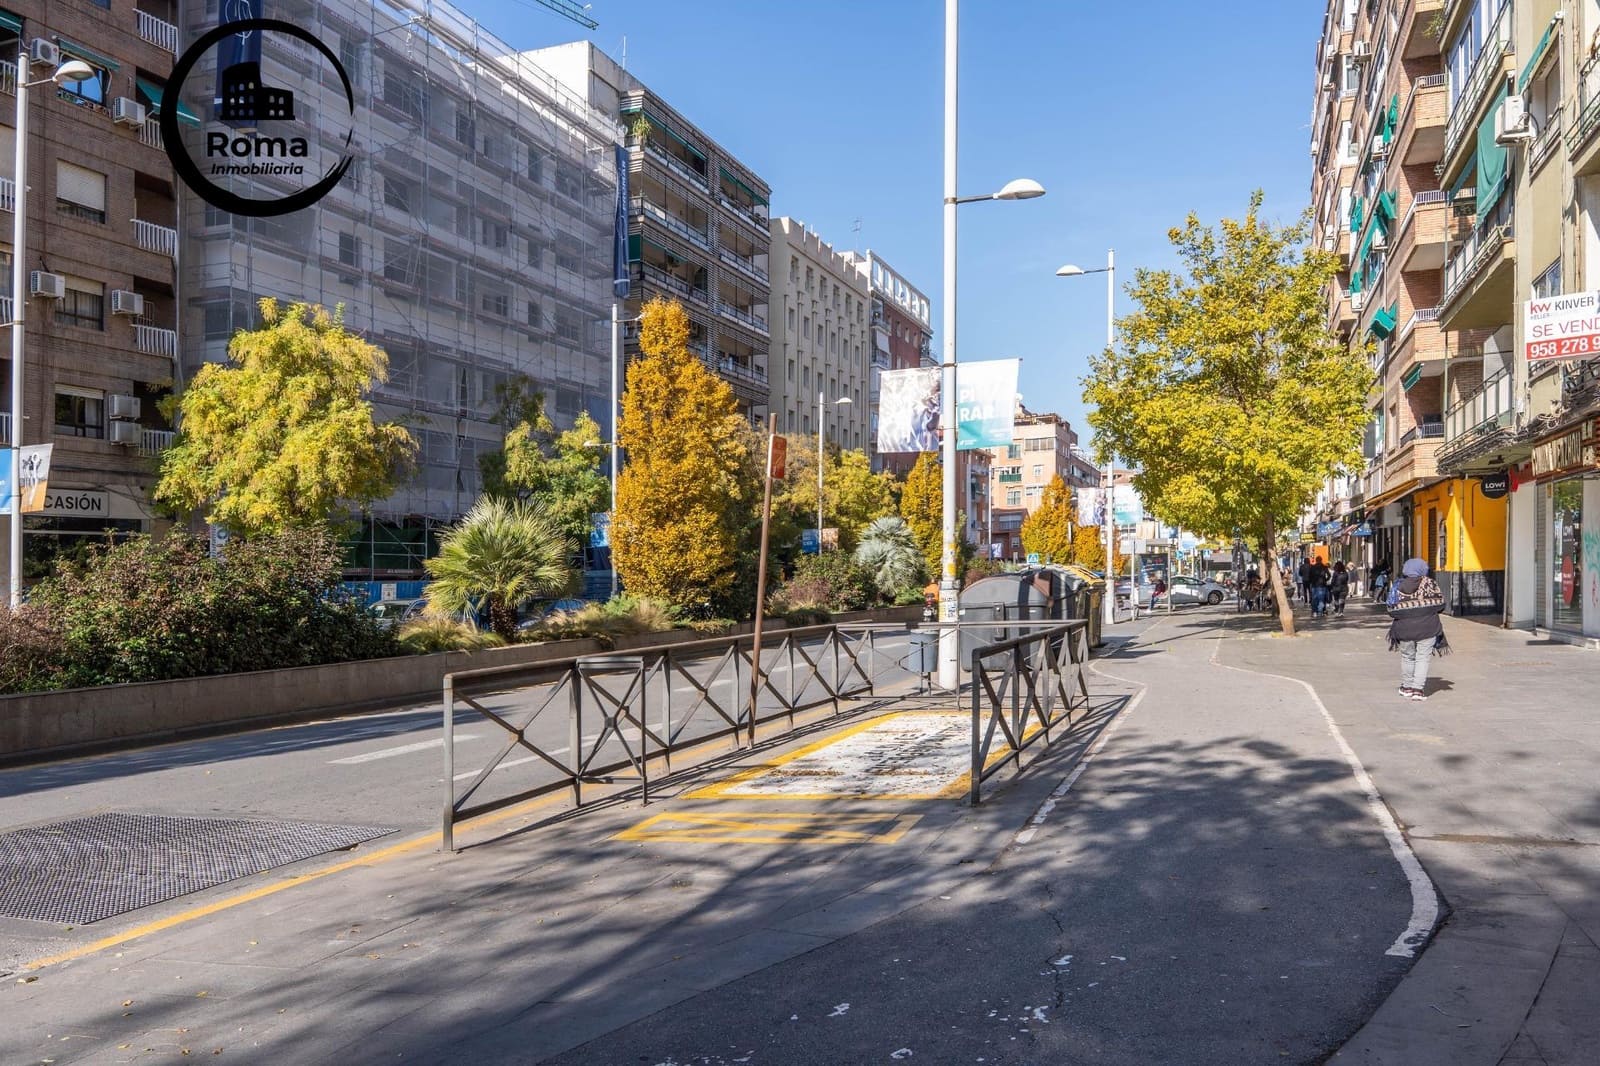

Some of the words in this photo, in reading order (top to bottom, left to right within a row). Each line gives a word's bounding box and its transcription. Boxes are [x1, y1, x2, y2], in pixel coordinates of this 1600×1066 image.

[1554, 296, 1595, 311] KINVER
[1532, 322, 1554, 338] SE
[1530, 341, 1557, 358] 958
[1561, 337, 1589, 354] 278
